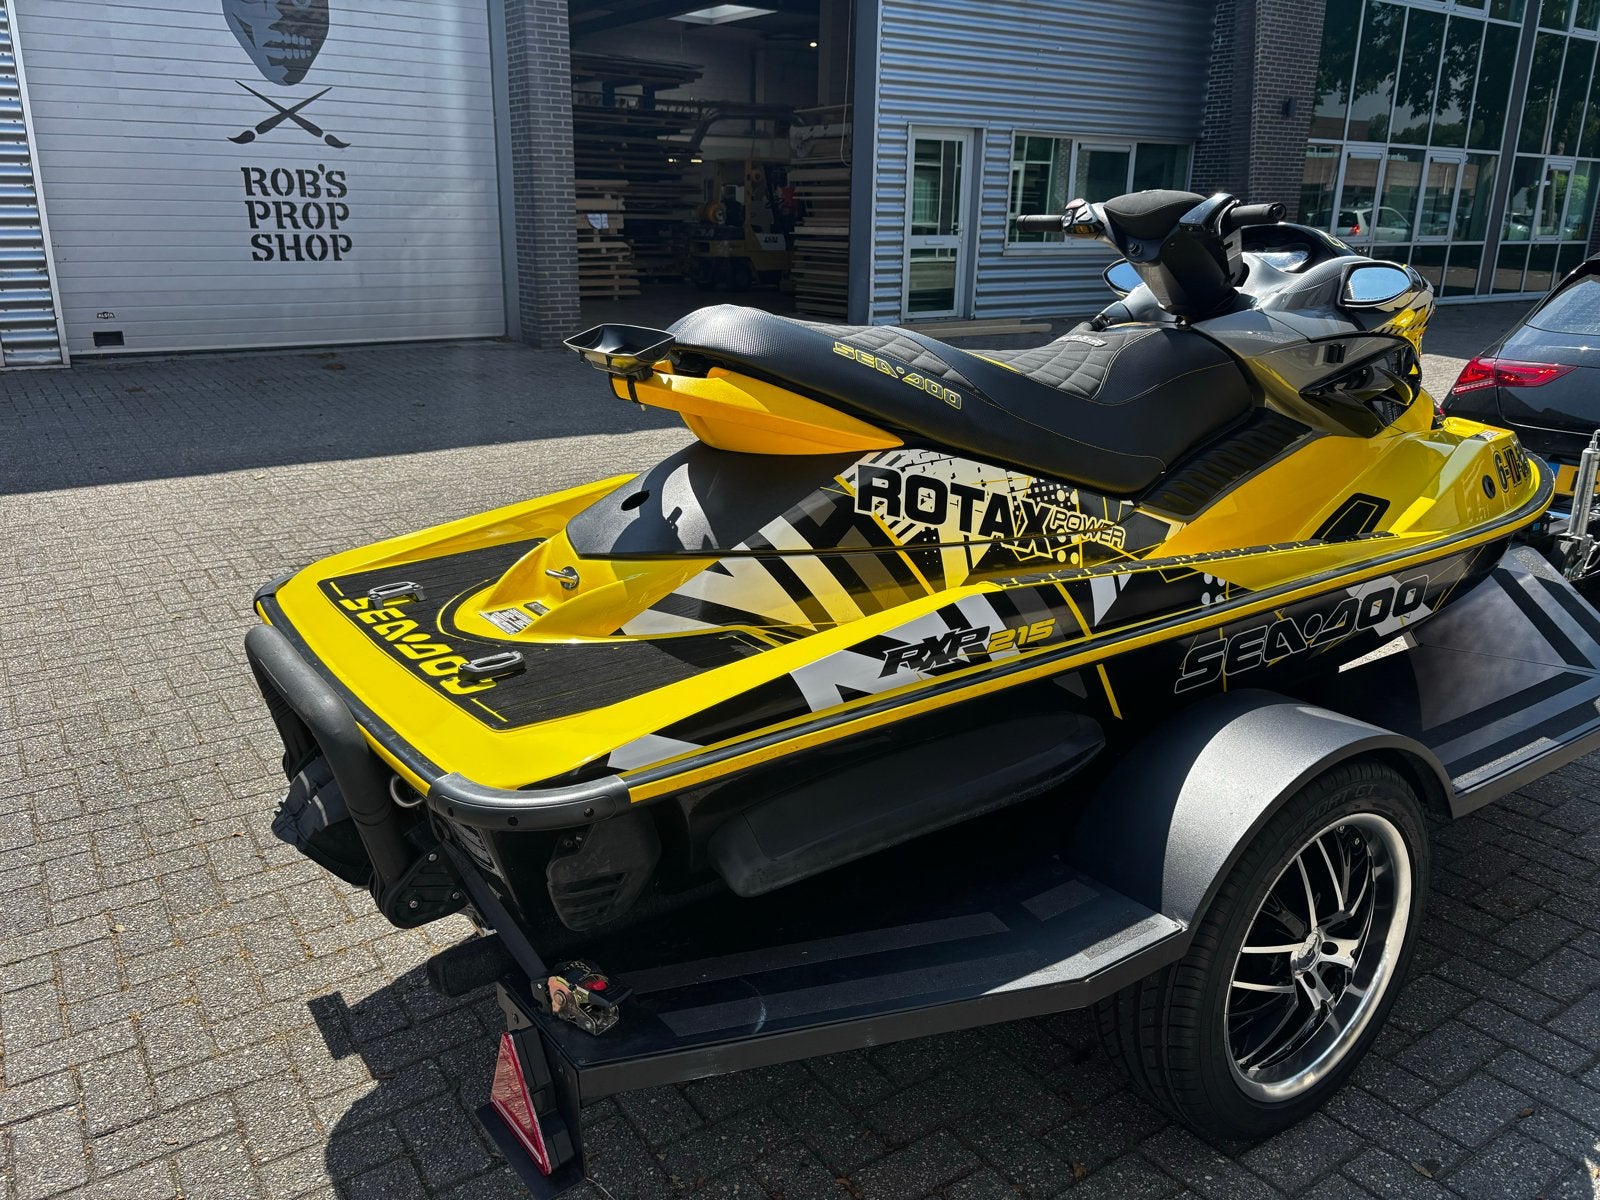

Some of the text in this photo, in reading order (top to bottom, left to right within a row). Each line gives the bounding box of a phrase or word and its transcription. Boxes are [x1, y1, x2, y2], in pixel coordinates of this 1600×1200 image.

[241, 164, 347, 198] ROB'S
[245, 200, 349, 229] PROP
[251, 234, 352, 261] SHOP
[854, 464, 1126, 558] ROTAX POWER
[987, 618, 1056, 653] 215
